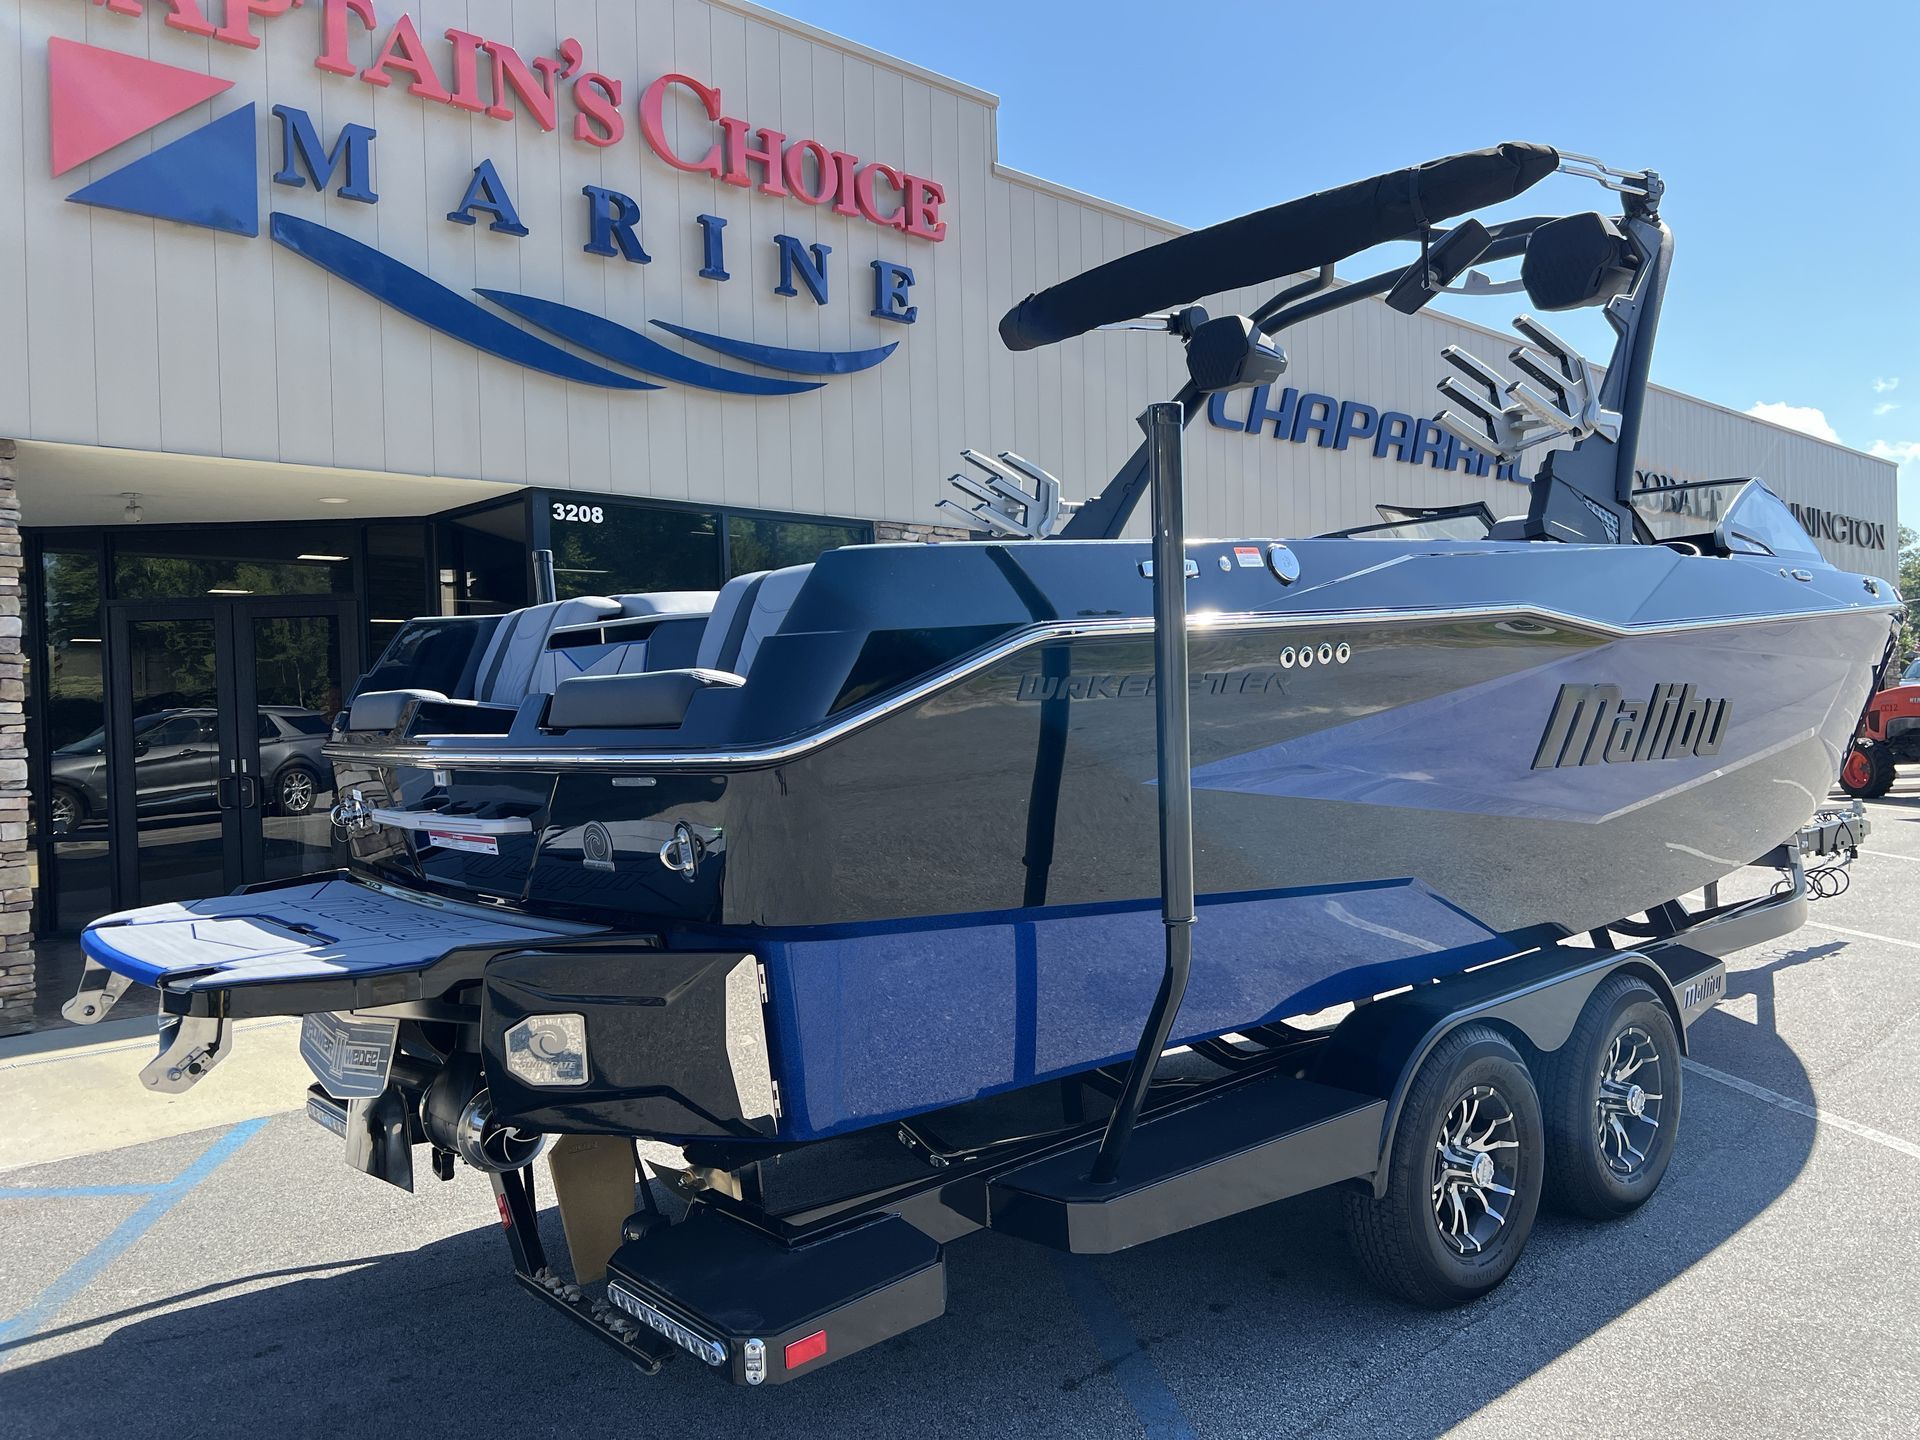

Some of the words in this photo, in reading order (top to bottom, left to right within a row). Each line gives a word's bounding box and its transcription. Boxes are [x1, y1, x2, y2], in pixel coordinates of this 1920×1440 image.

[93, 0, 624, 148] PTAIN'S
[640, 73, 948, 243] CHOICE
[272, 104, 918, 324] MARINE
[552, 503, 604, 524] 3208
[1530, 683, 1734, 771] Malibu
[1683, 975, 1722, 1010] Malibu
